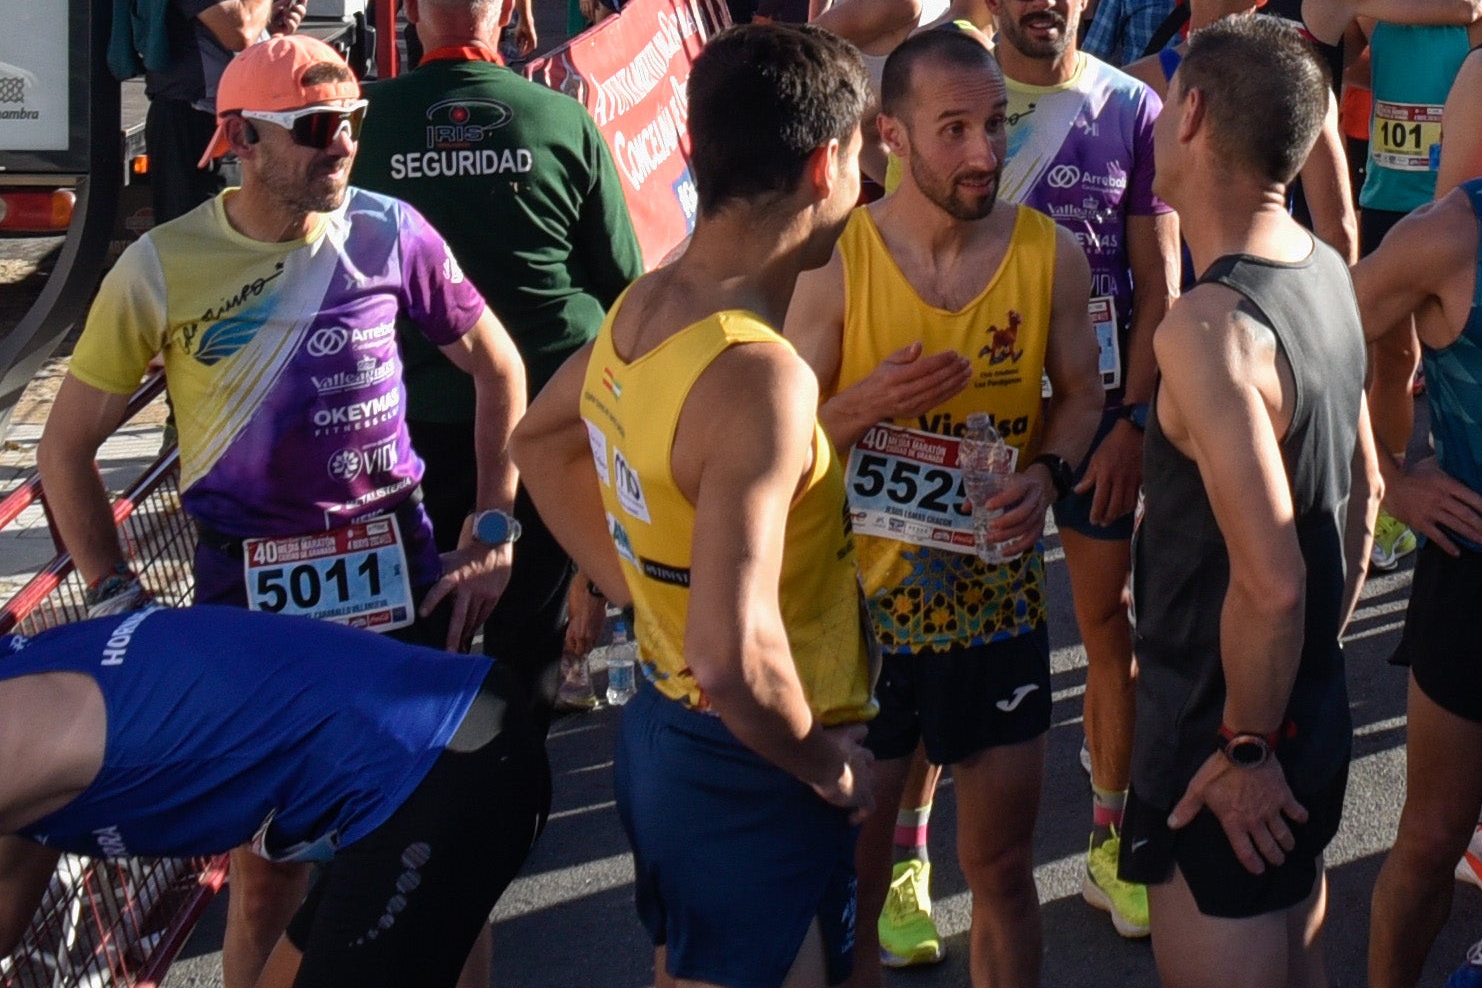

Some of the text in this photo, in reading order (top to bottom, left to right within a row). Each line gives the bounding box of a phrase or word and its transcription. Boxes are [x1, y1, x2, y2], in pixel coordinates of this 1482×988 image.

[426, 125, 485, 149] IRIS
[1380, 121, 1422, 149] 101
[390, 148, 533, 180] SEGURIDAD
[862, 427, 889, 450] 40
[252, 540, 278, 565] 40
[257, 552, 382, 613] 5011
